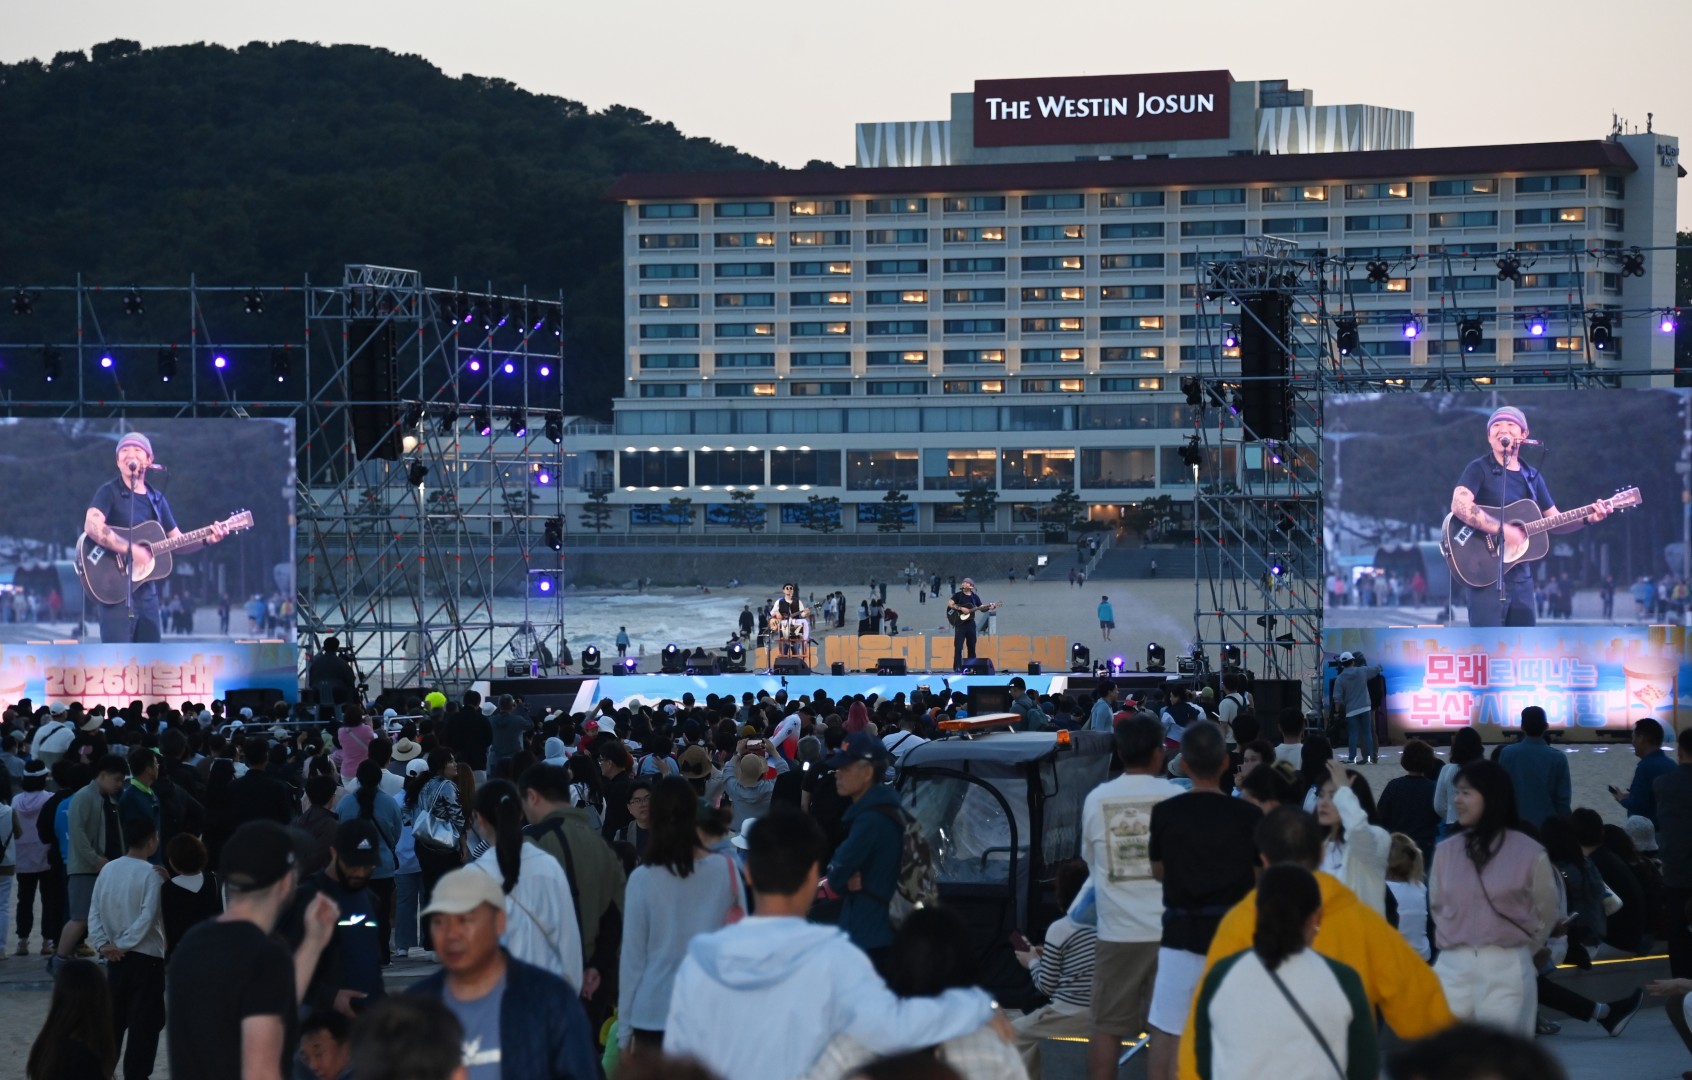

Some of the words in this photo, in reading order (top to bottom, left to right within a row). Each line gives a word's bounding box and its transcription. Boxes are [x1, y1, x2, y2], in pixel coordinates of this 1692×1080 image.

[985, 98, 1031, 120] THE
[1036, 95, 1128, 118] WESTIN
[1136, 92, 1214, 119] JOSUN
[1425, 653, 1516, 687] 모래로
[1518, 657, 1598, 687] 떠나는
[1409, 693, 1474, 726] 부산
